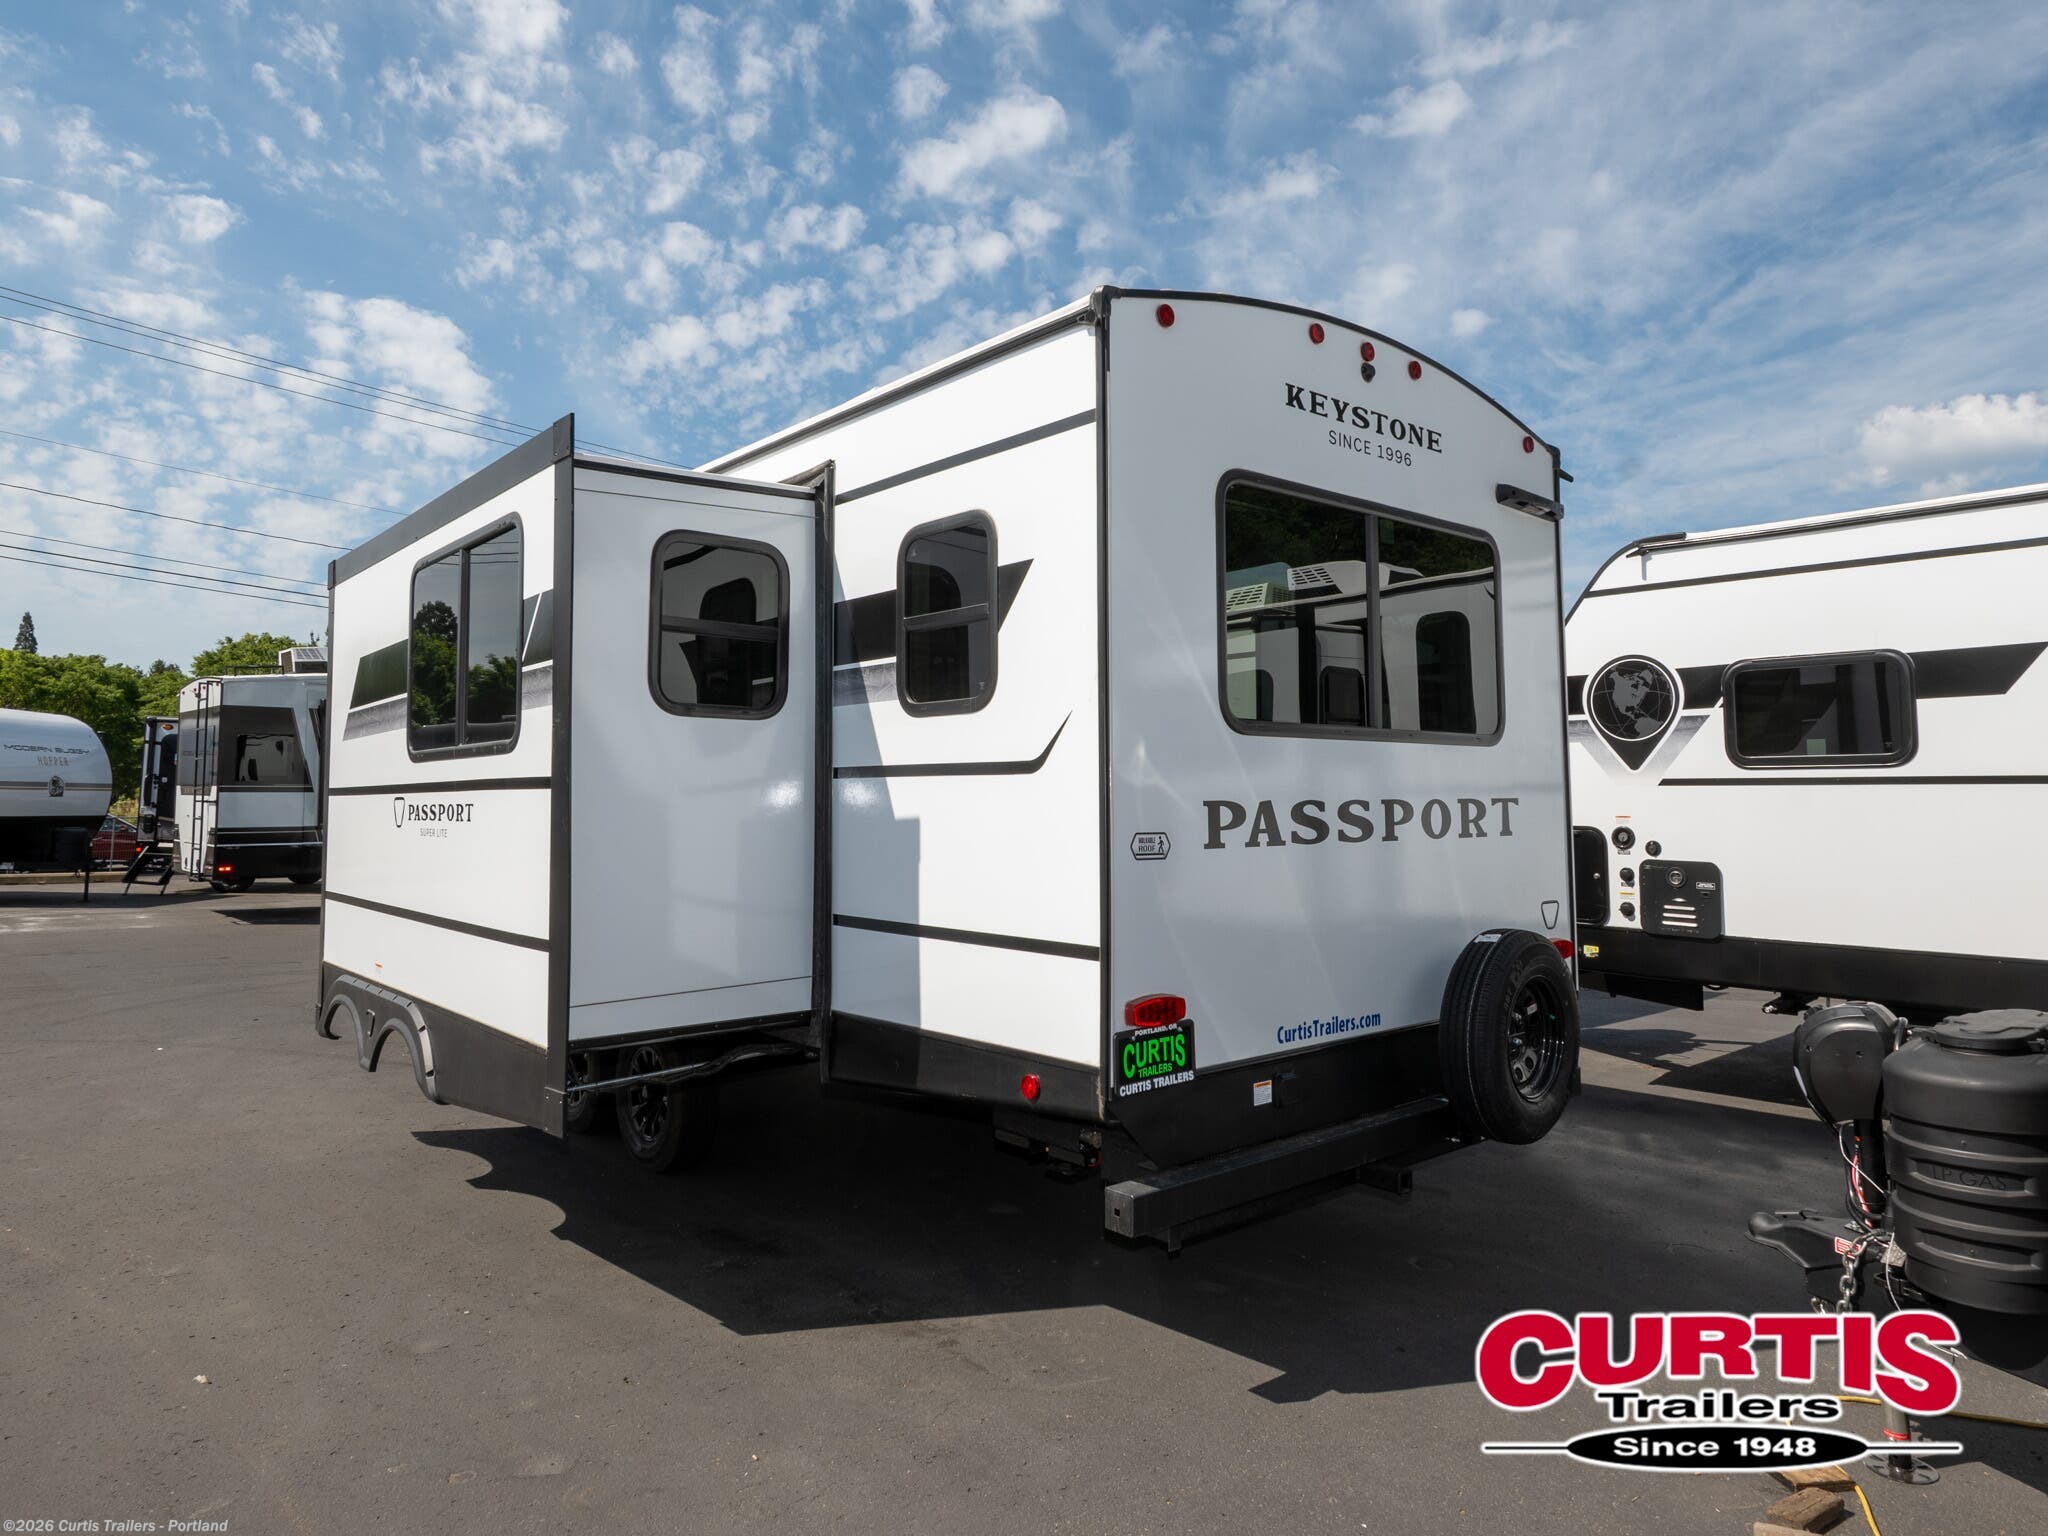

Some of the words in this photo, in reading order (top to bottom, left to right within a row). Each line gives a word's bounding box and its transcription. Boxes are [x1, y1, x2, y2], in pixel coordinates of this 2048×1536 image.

[1285, 382, 1442, 453] KEYSTONE
[1328, 430, 1371, 455] SINCE
[1377, 445, 1412, 467] 1996
[408, 803, 474, 822] PASSPORT
[1203, 797, 1519, 850] PASSPORT
[1277, 1013, 1381, 1044] CurtisTrailers.com
[1123, 1033, 1186, 1078] CURTIS
[1138, 1062, 1173, 1079] TRAILERS
[1120, 1079, 1152, 1097] CURTIS
[1152, 1070, 1195, 1088] TRAILERS
